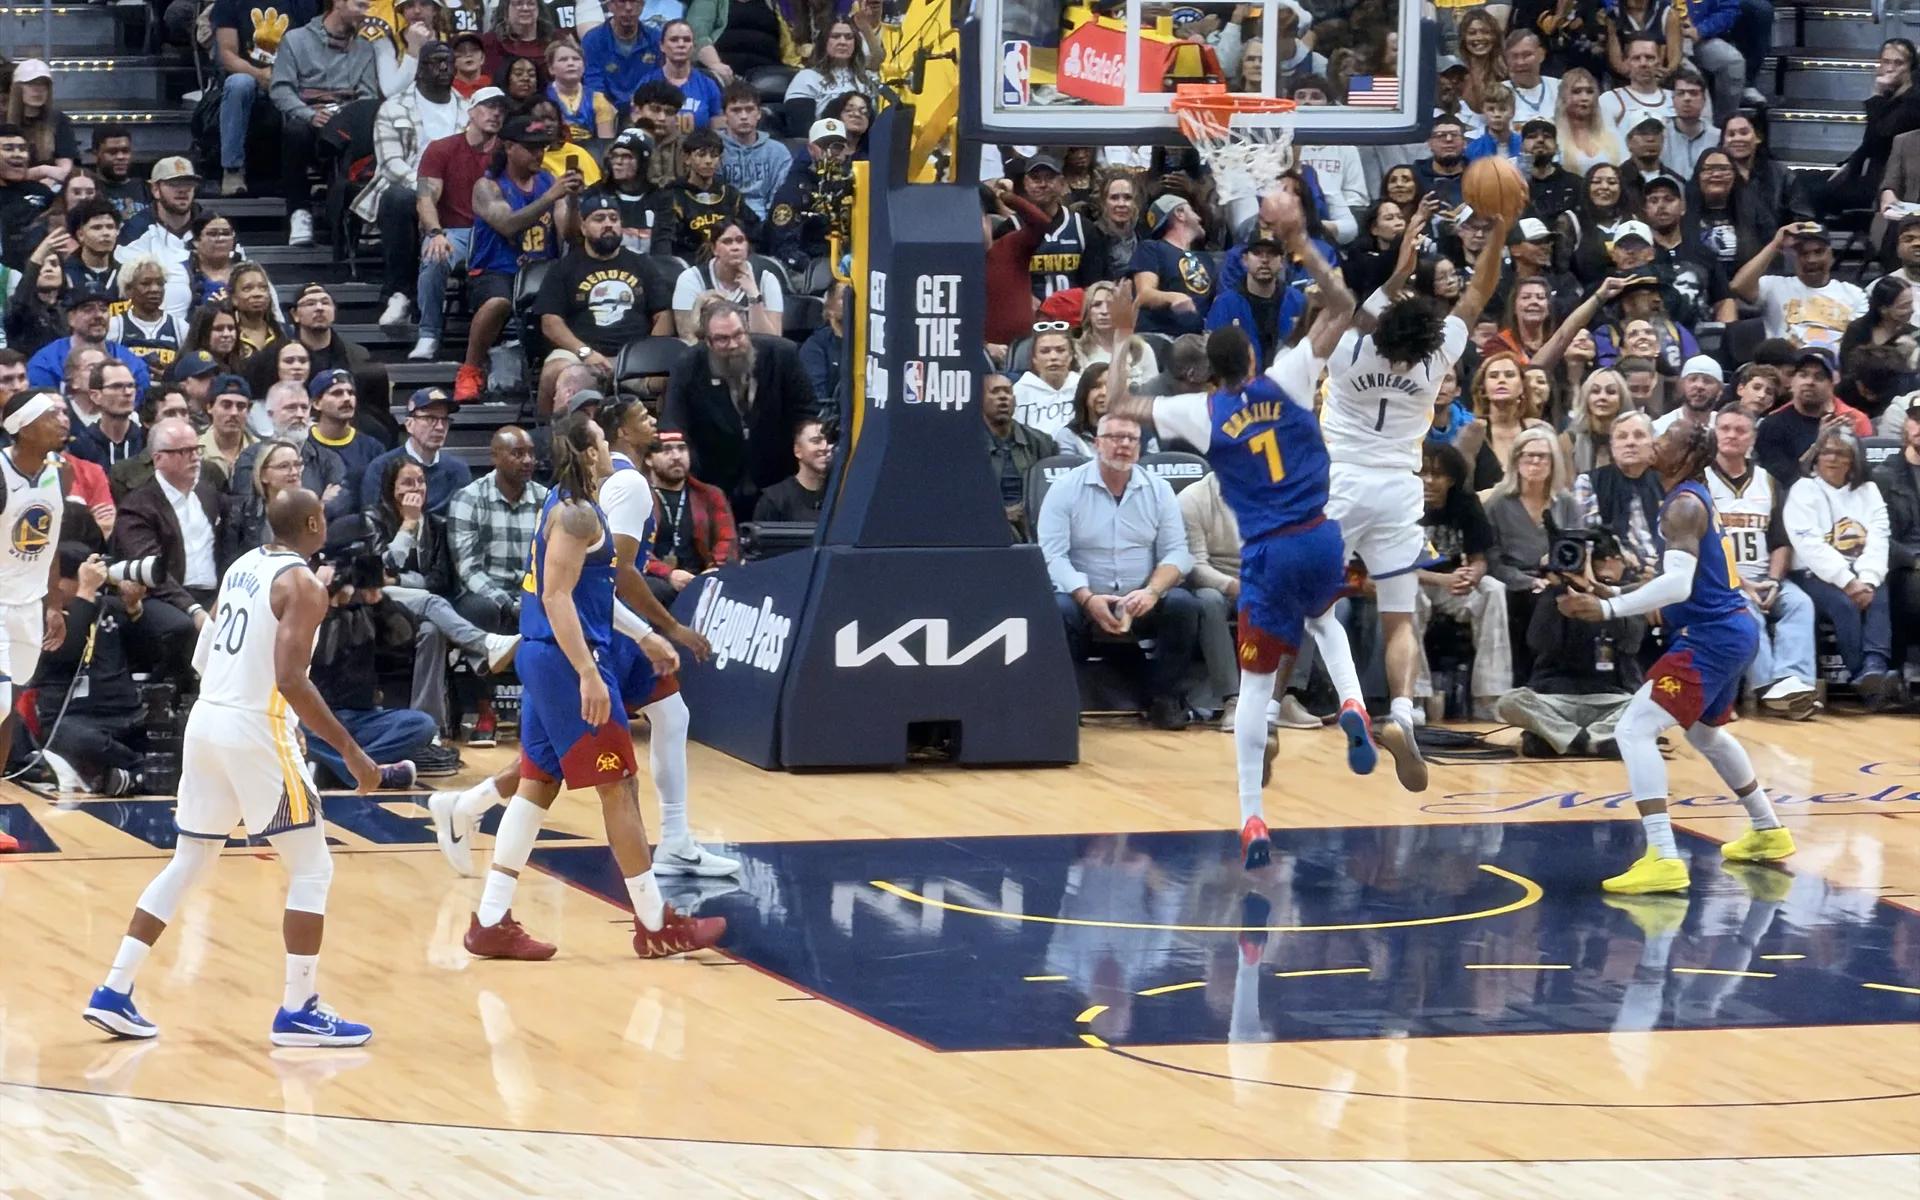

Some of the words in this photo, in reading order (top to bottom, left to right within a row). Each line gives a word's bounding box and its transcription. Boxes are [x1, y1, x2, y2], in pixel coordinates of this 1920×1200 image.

[578, 269, 639, 292] DENVER
[916, 274, 962, 314] GET
[915, 318, 961, 357] THE
[924, 361, 972, 411] App
[1374, 397, 1388, 432] 1
[1248, 428, 1286, 483] 7
[1731, 531, 1758, 562] 15
[213, 602, 249, 656] 20
[702, 580, 759, 670] League
[745, 595, 792, 673] Pass
[835, 617, 1028, 667] KIA
